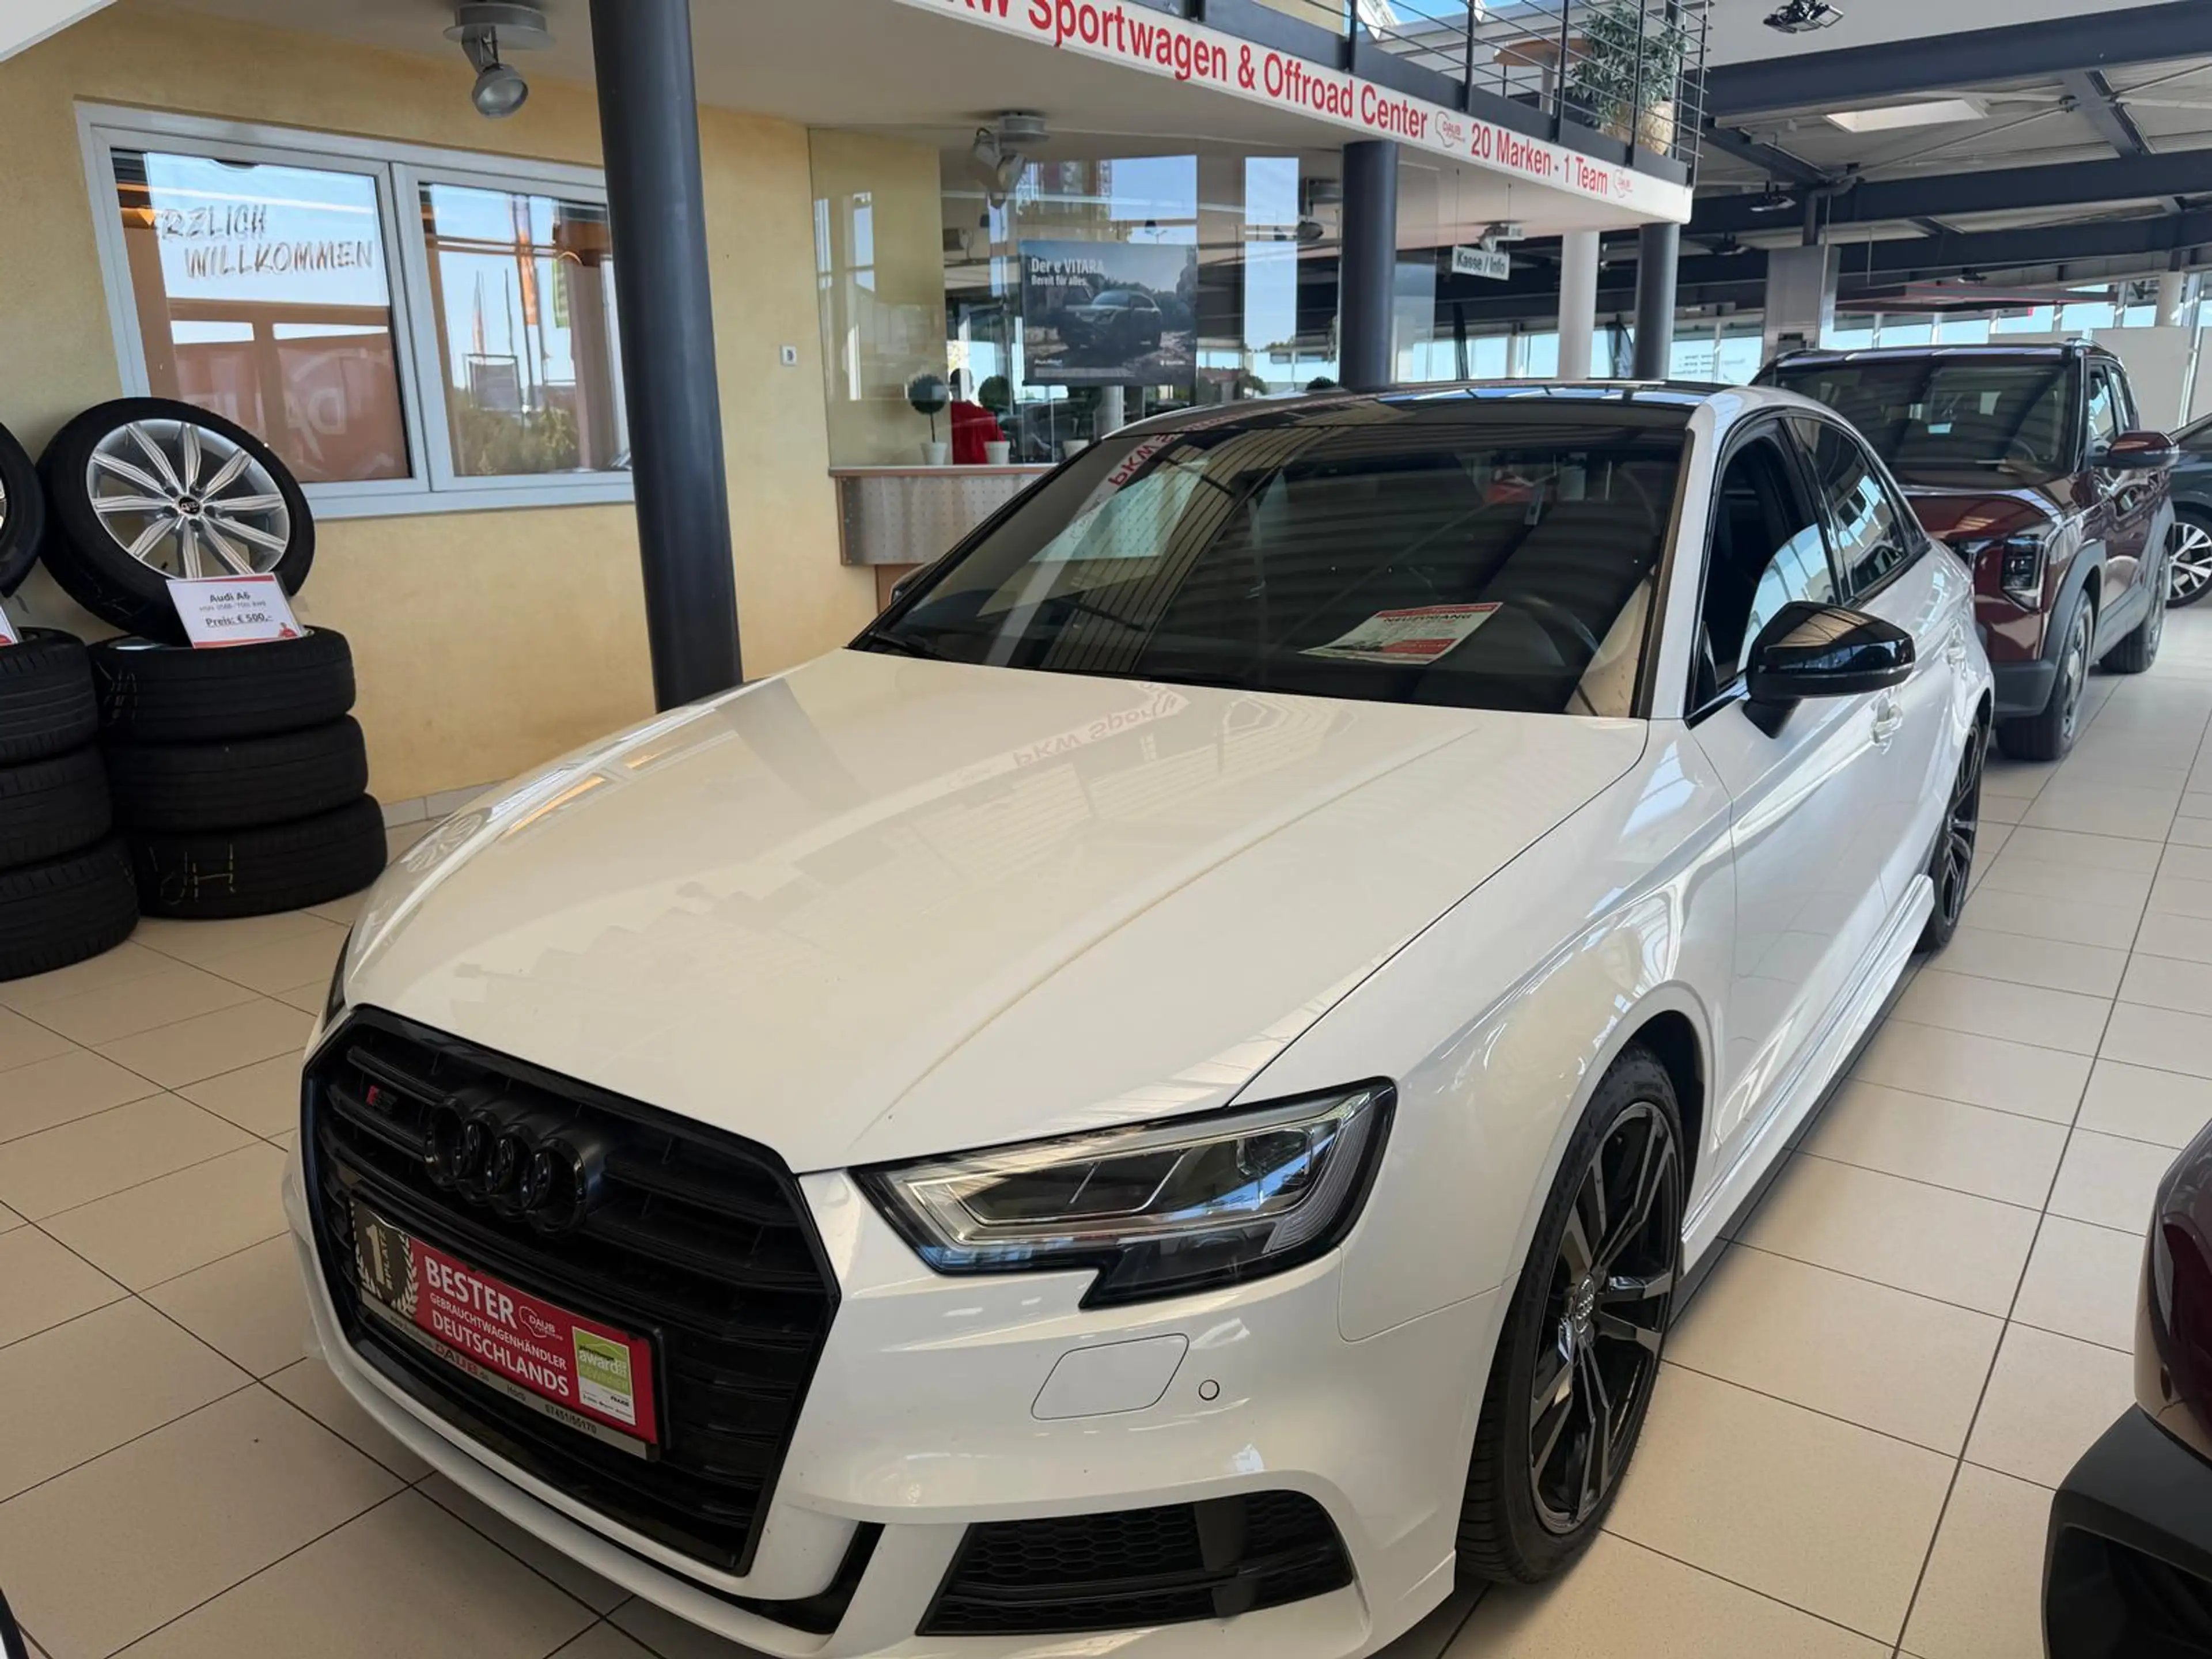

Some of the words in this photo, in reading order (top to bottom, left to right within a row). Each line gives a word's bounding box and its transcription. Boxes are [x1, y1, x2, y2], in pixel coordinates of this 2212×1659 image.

[1028, 0, 1226, 80] Sportwagen
[1237, 44, 1256, 90] &
[1264, 53, 1354, 119] Offroad
[1361, 86, 1427, 140] Center
[1471, 123, 1491, 160] 20
[1498, 128, 1552, 177] Marken
[1563, 156, 1570, 183] 1
[1575, 158, 1608, 195] Team
[162, 204, 267, 240] RZLICH
[185, 240, 373, 278] WILLKOMMEN
[1031, 257, 1051, 273] Der
[1064, 258, 1104, 274] VITARA
[1457, 251, 1482, 271] Kasse
[1490, 256, 1505, 275] Info
[1031, 275, 1054, 286] Bereit
[1056, 275, 1067, 286] für
[210, 592, 233, 603] Audi
[205, 616, 234, 627] Preis:
[425, 1255, 518, 1330] BESTER
[430, 1292, 567, 1371] GEBRAUCHTWAGENHÄNDLER
[528, 1315, 555, 1333] DAUB
[432, 1309, 570, 1397] DEUTSCHLANDS
[578, 1350, 619, 1375] award
